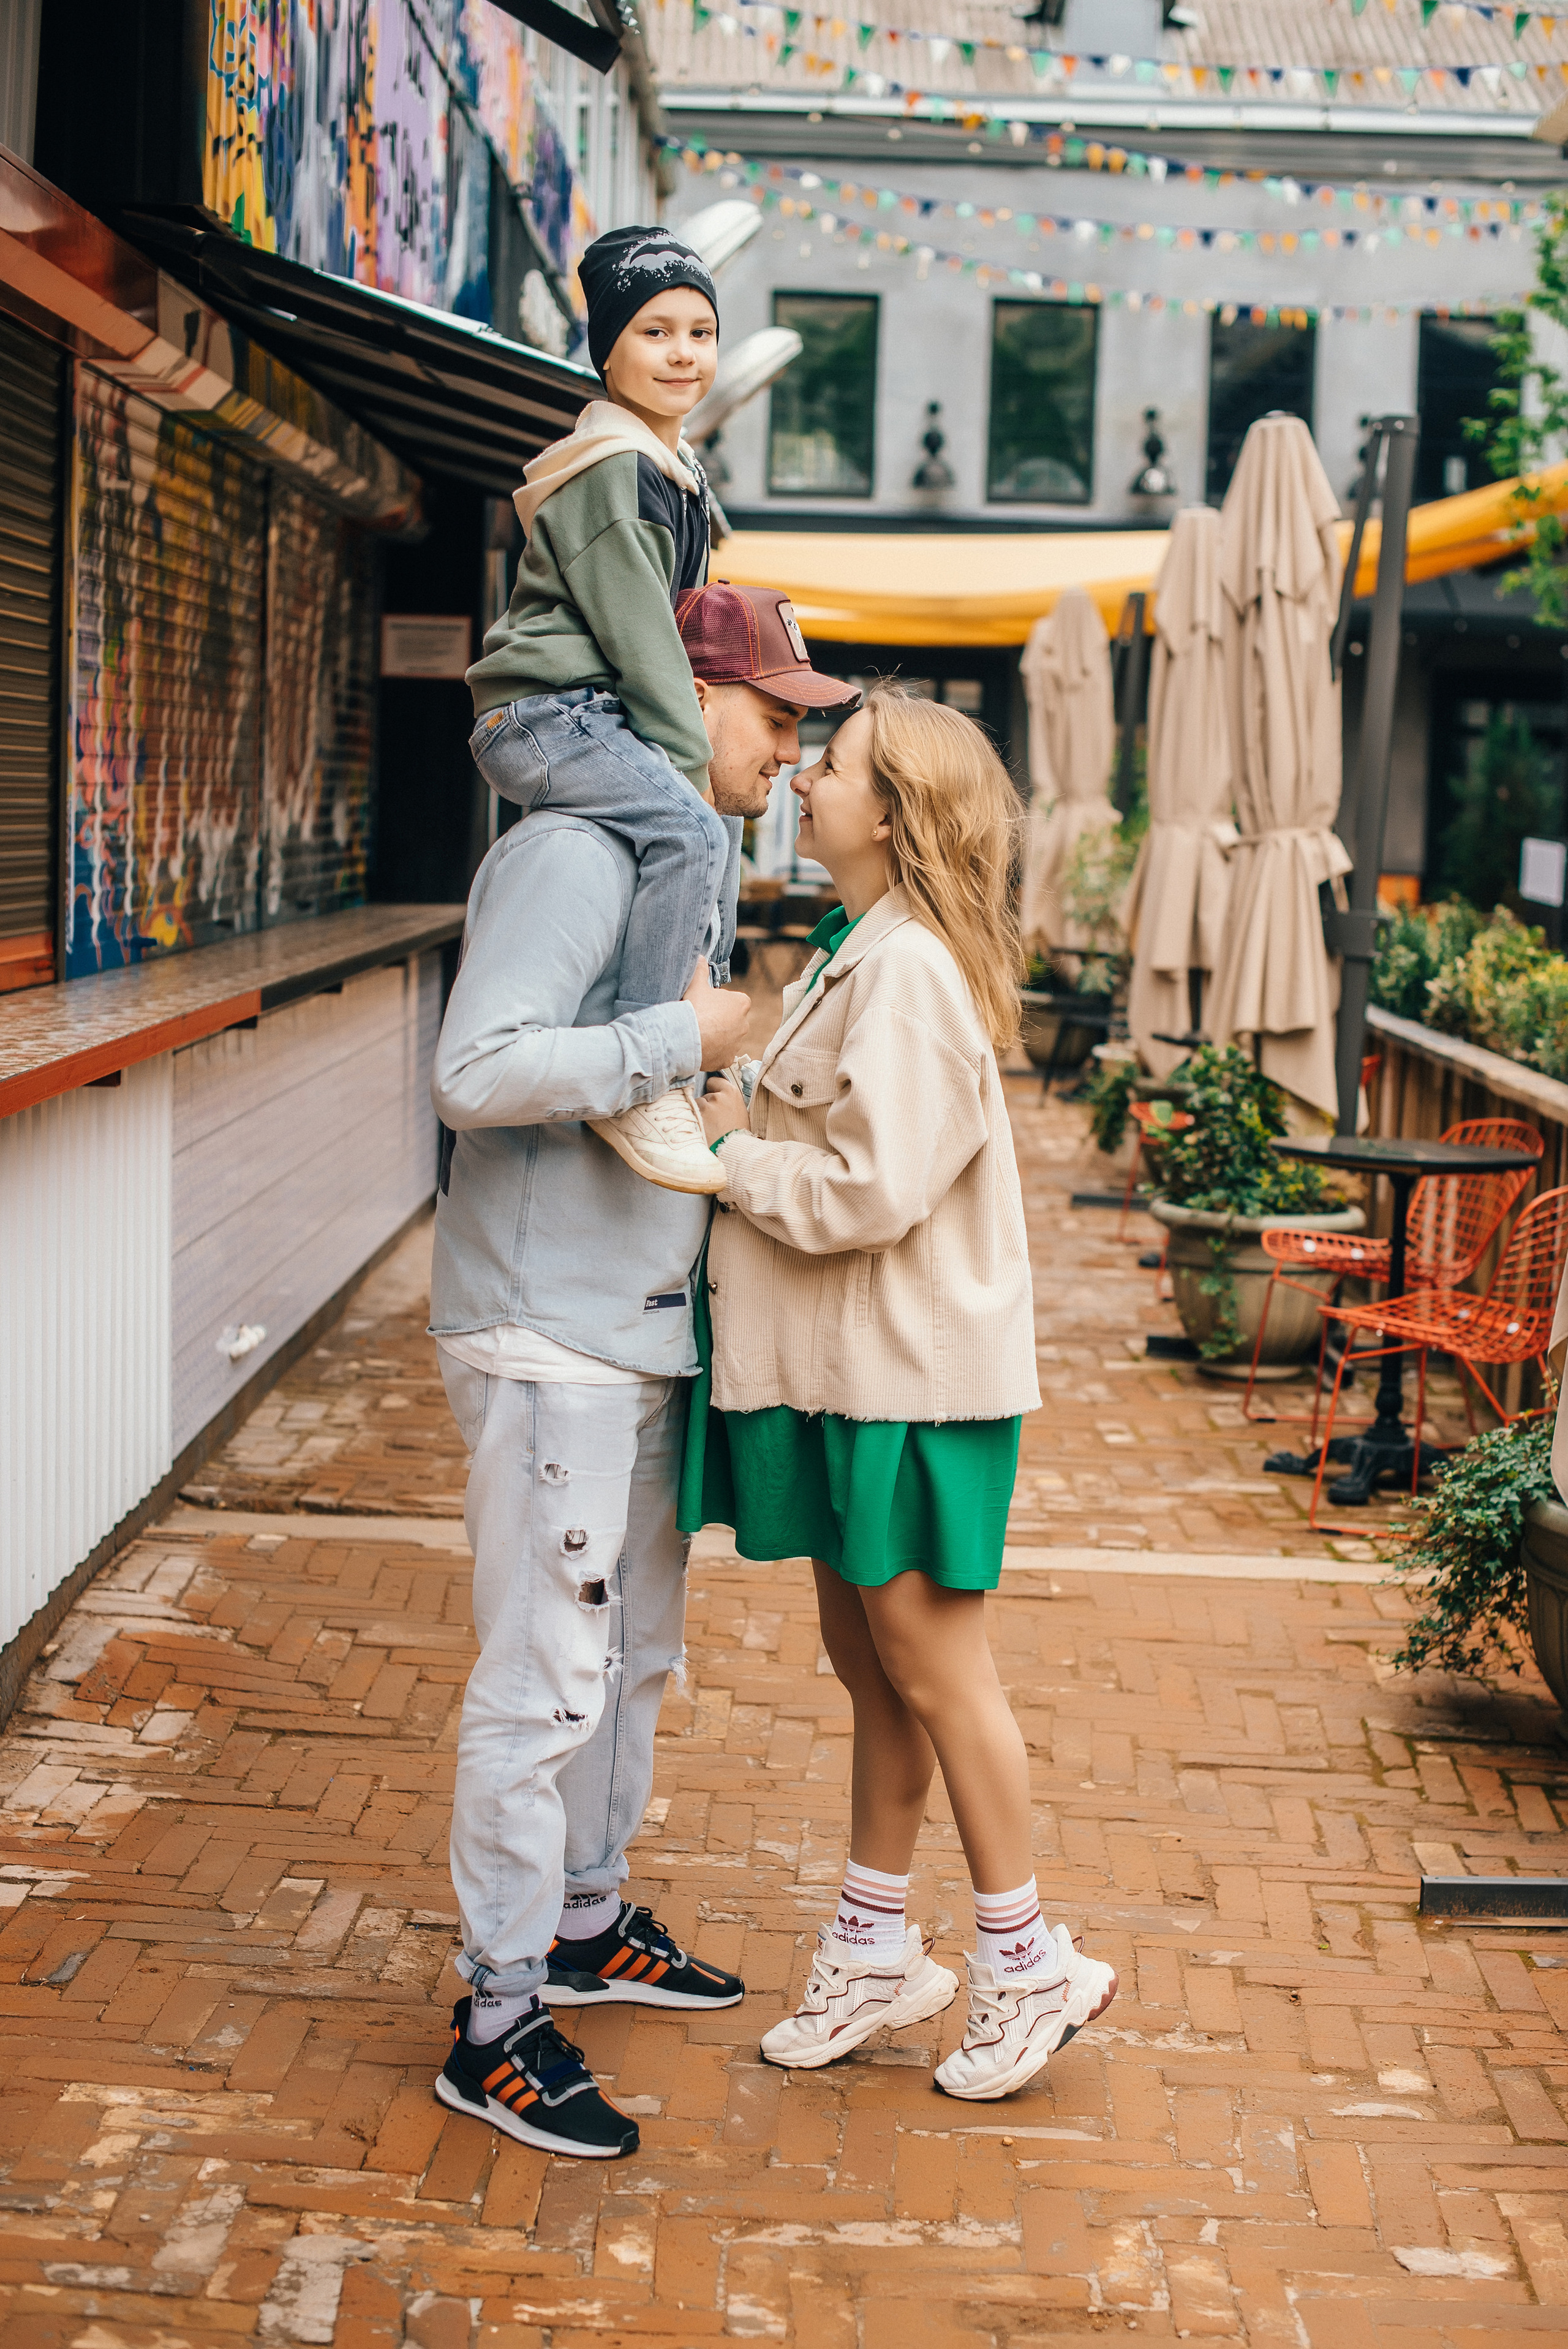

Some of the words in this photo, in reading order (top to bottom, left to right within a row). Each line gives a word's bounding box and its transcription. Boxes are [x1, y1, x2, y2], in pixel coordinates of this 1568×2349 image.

[564, 1895, 607, 1909] adidas
[832, 1932, 876, 1945] adidas
[1004, 1949, 1047, 1973] adidas
[473, 1998, 502, 2008] didas
